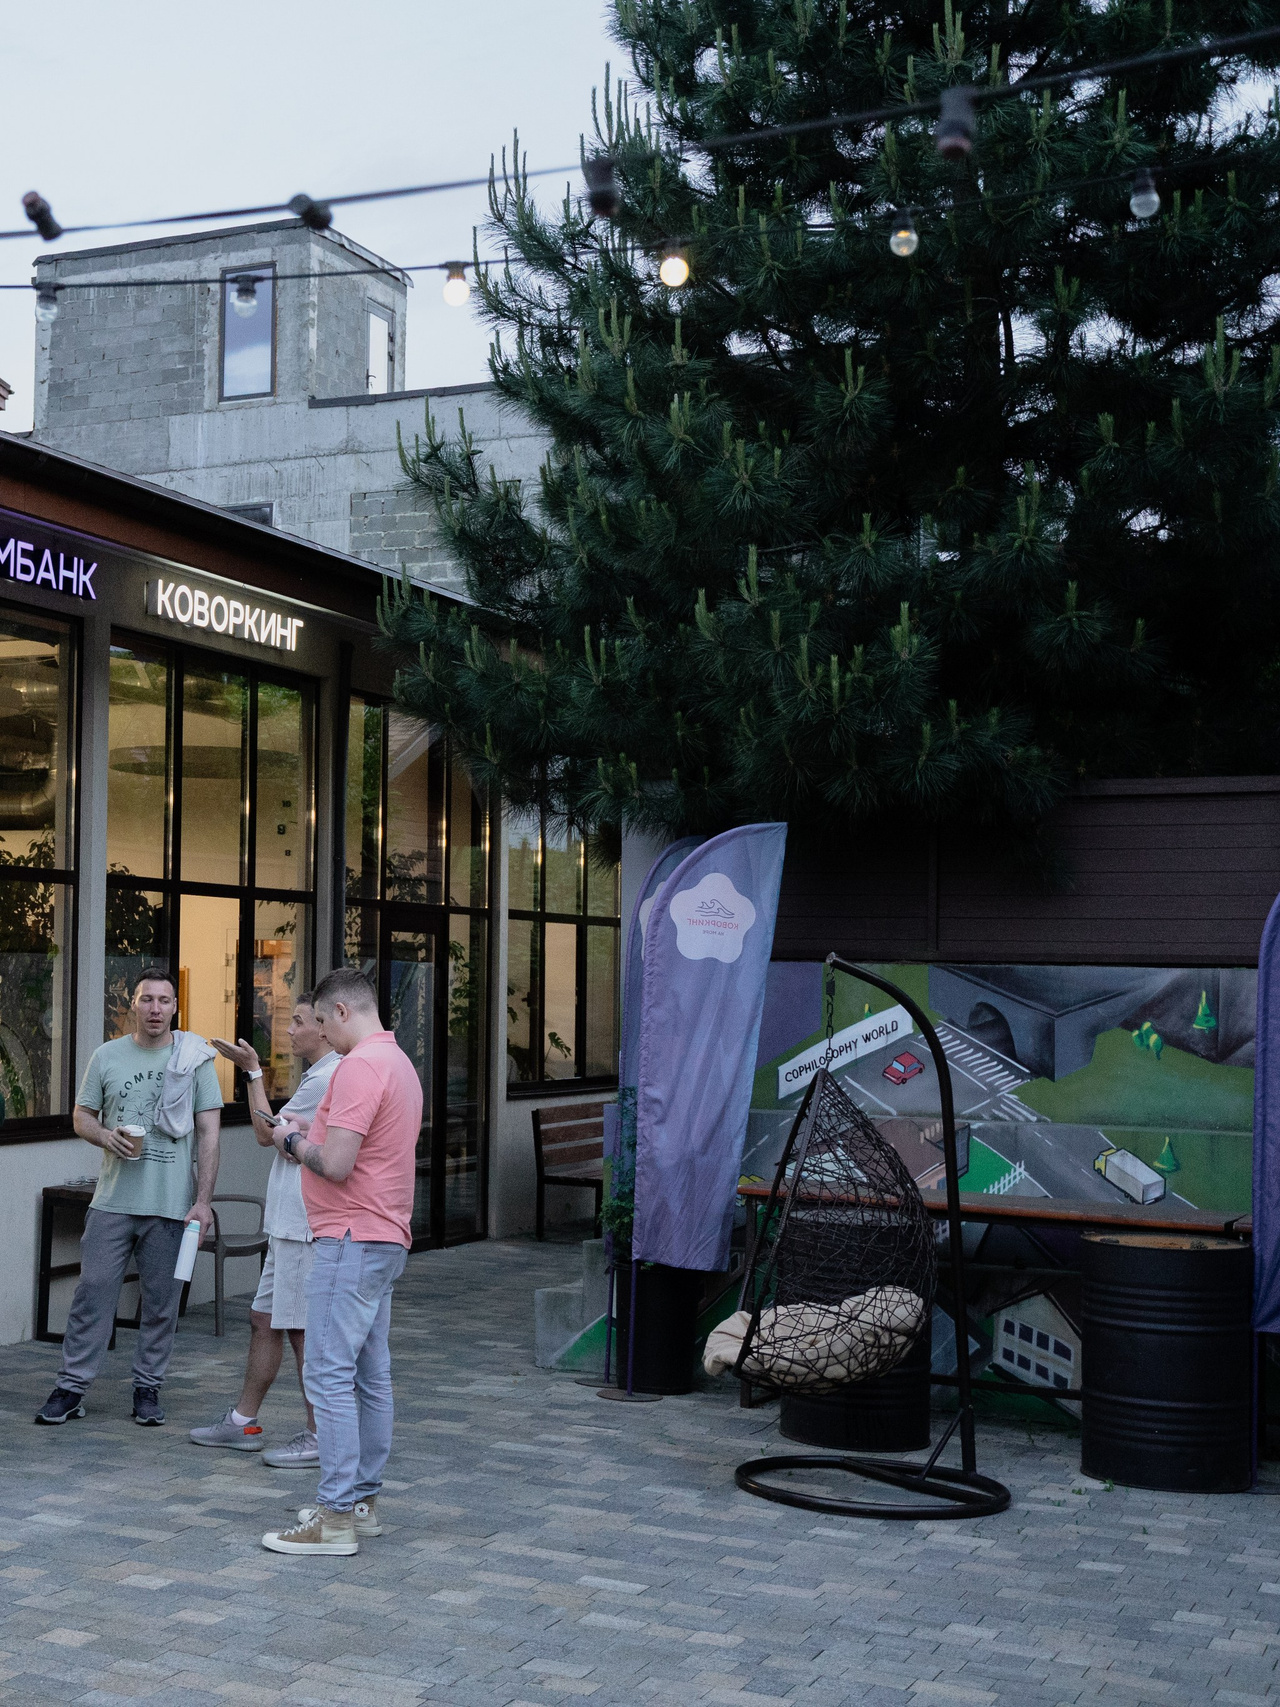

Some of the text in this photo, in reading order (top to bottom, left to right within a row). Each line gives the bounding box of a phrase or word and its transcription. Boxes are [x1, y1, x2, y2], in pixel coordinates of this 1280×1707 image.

[157, 579, 304, 651] КОВОРКИНГ
[278, 824, 286, 834] 9
[862, 1020, 898, 1044] WORLD
[119, 1070, 164, 1098] COMES
